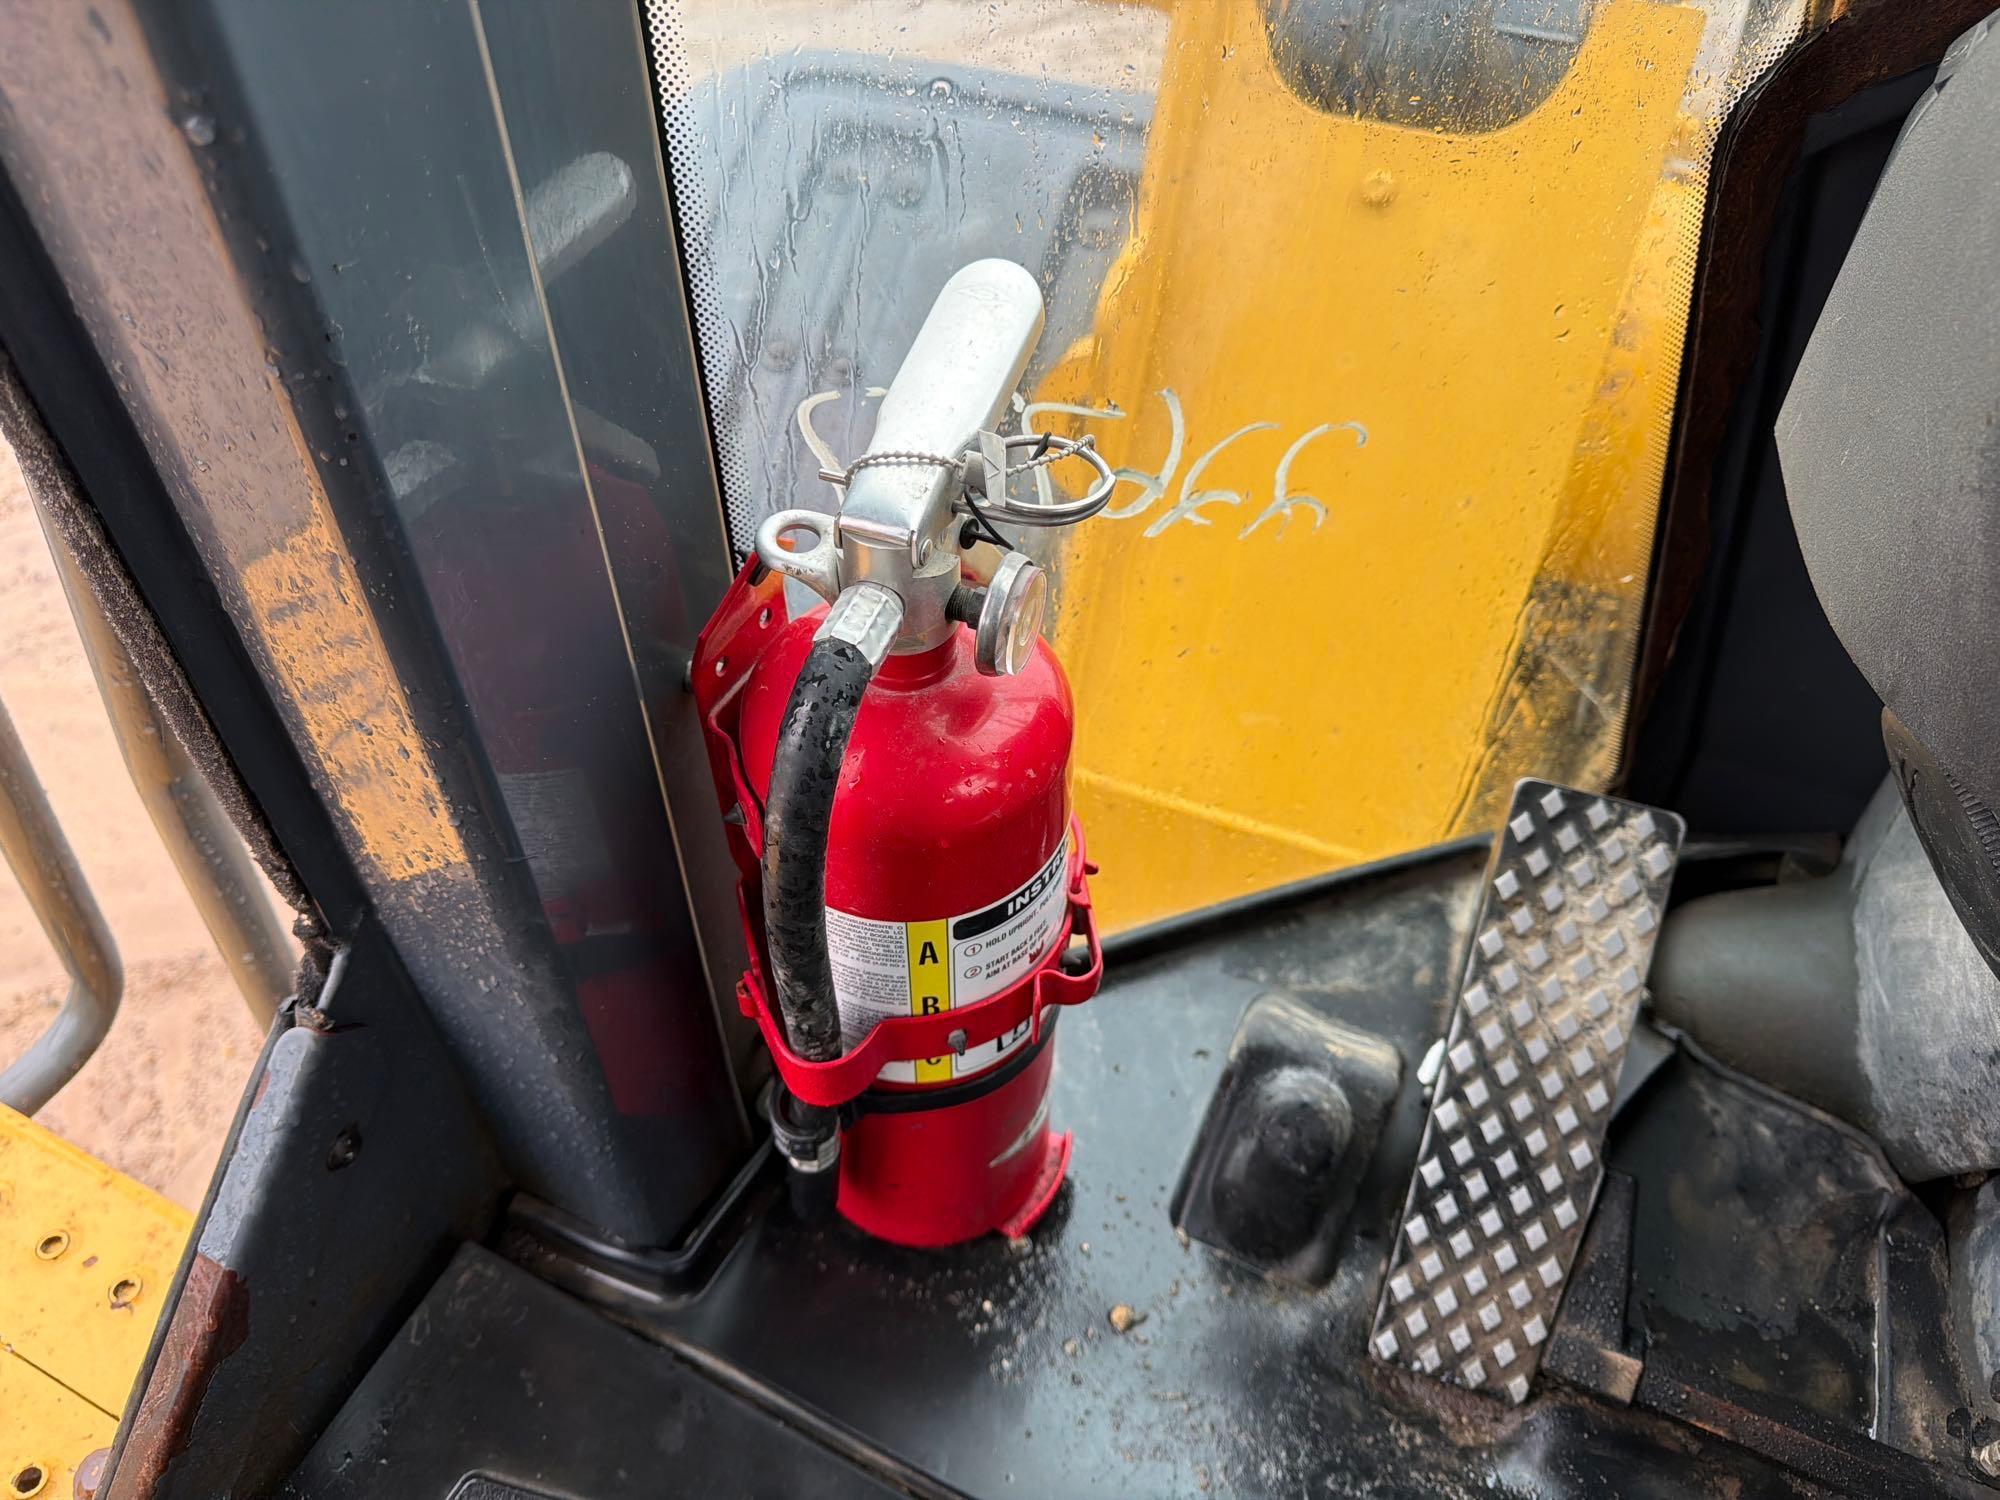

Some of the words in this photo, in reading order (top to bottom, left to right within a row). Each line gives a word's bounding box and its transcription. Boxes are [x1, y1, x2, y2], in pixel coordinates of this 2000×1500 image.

[986, 933, 1006, 948] HOLD
[918, 941, 939, 965] A
[985, 967, 1000, 979] AIM
[1002, 961, 1011, 971] AT
[1012, 948, 1028, 964] BASE
[986, 952, 1009, 969] START
[1011, 938, 1028, 955] BACK
[923, 996, 940, 1015] B
